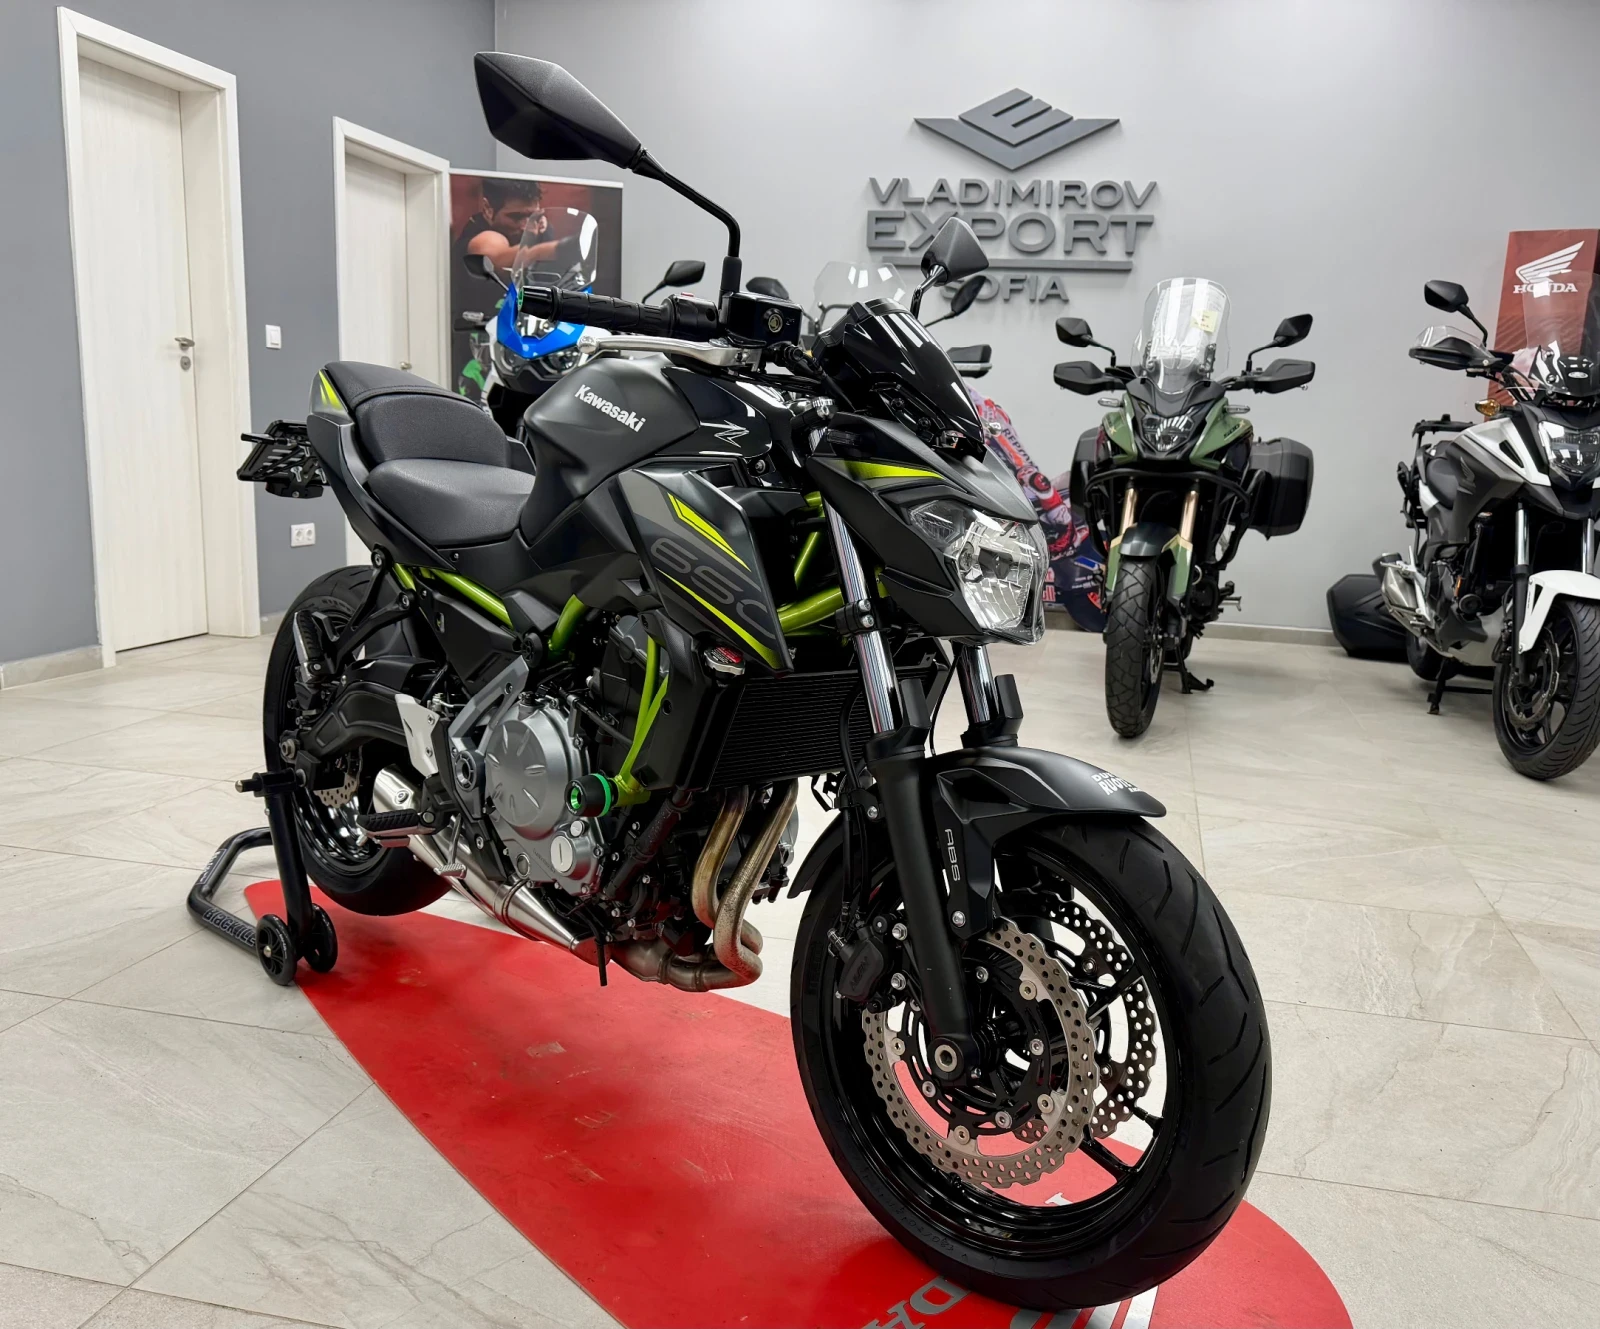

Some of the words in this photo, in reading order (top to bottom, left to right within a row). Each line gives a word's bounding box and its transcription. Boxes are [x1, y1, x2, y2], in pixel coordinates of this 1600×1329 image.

[868, 176, 1158, 208] VLADIMIROV
[867, 210, 1154, 255] EXPORT
[574, 384, 647, 433] Kawasaki
[944, 828, 961, 882] ABS
